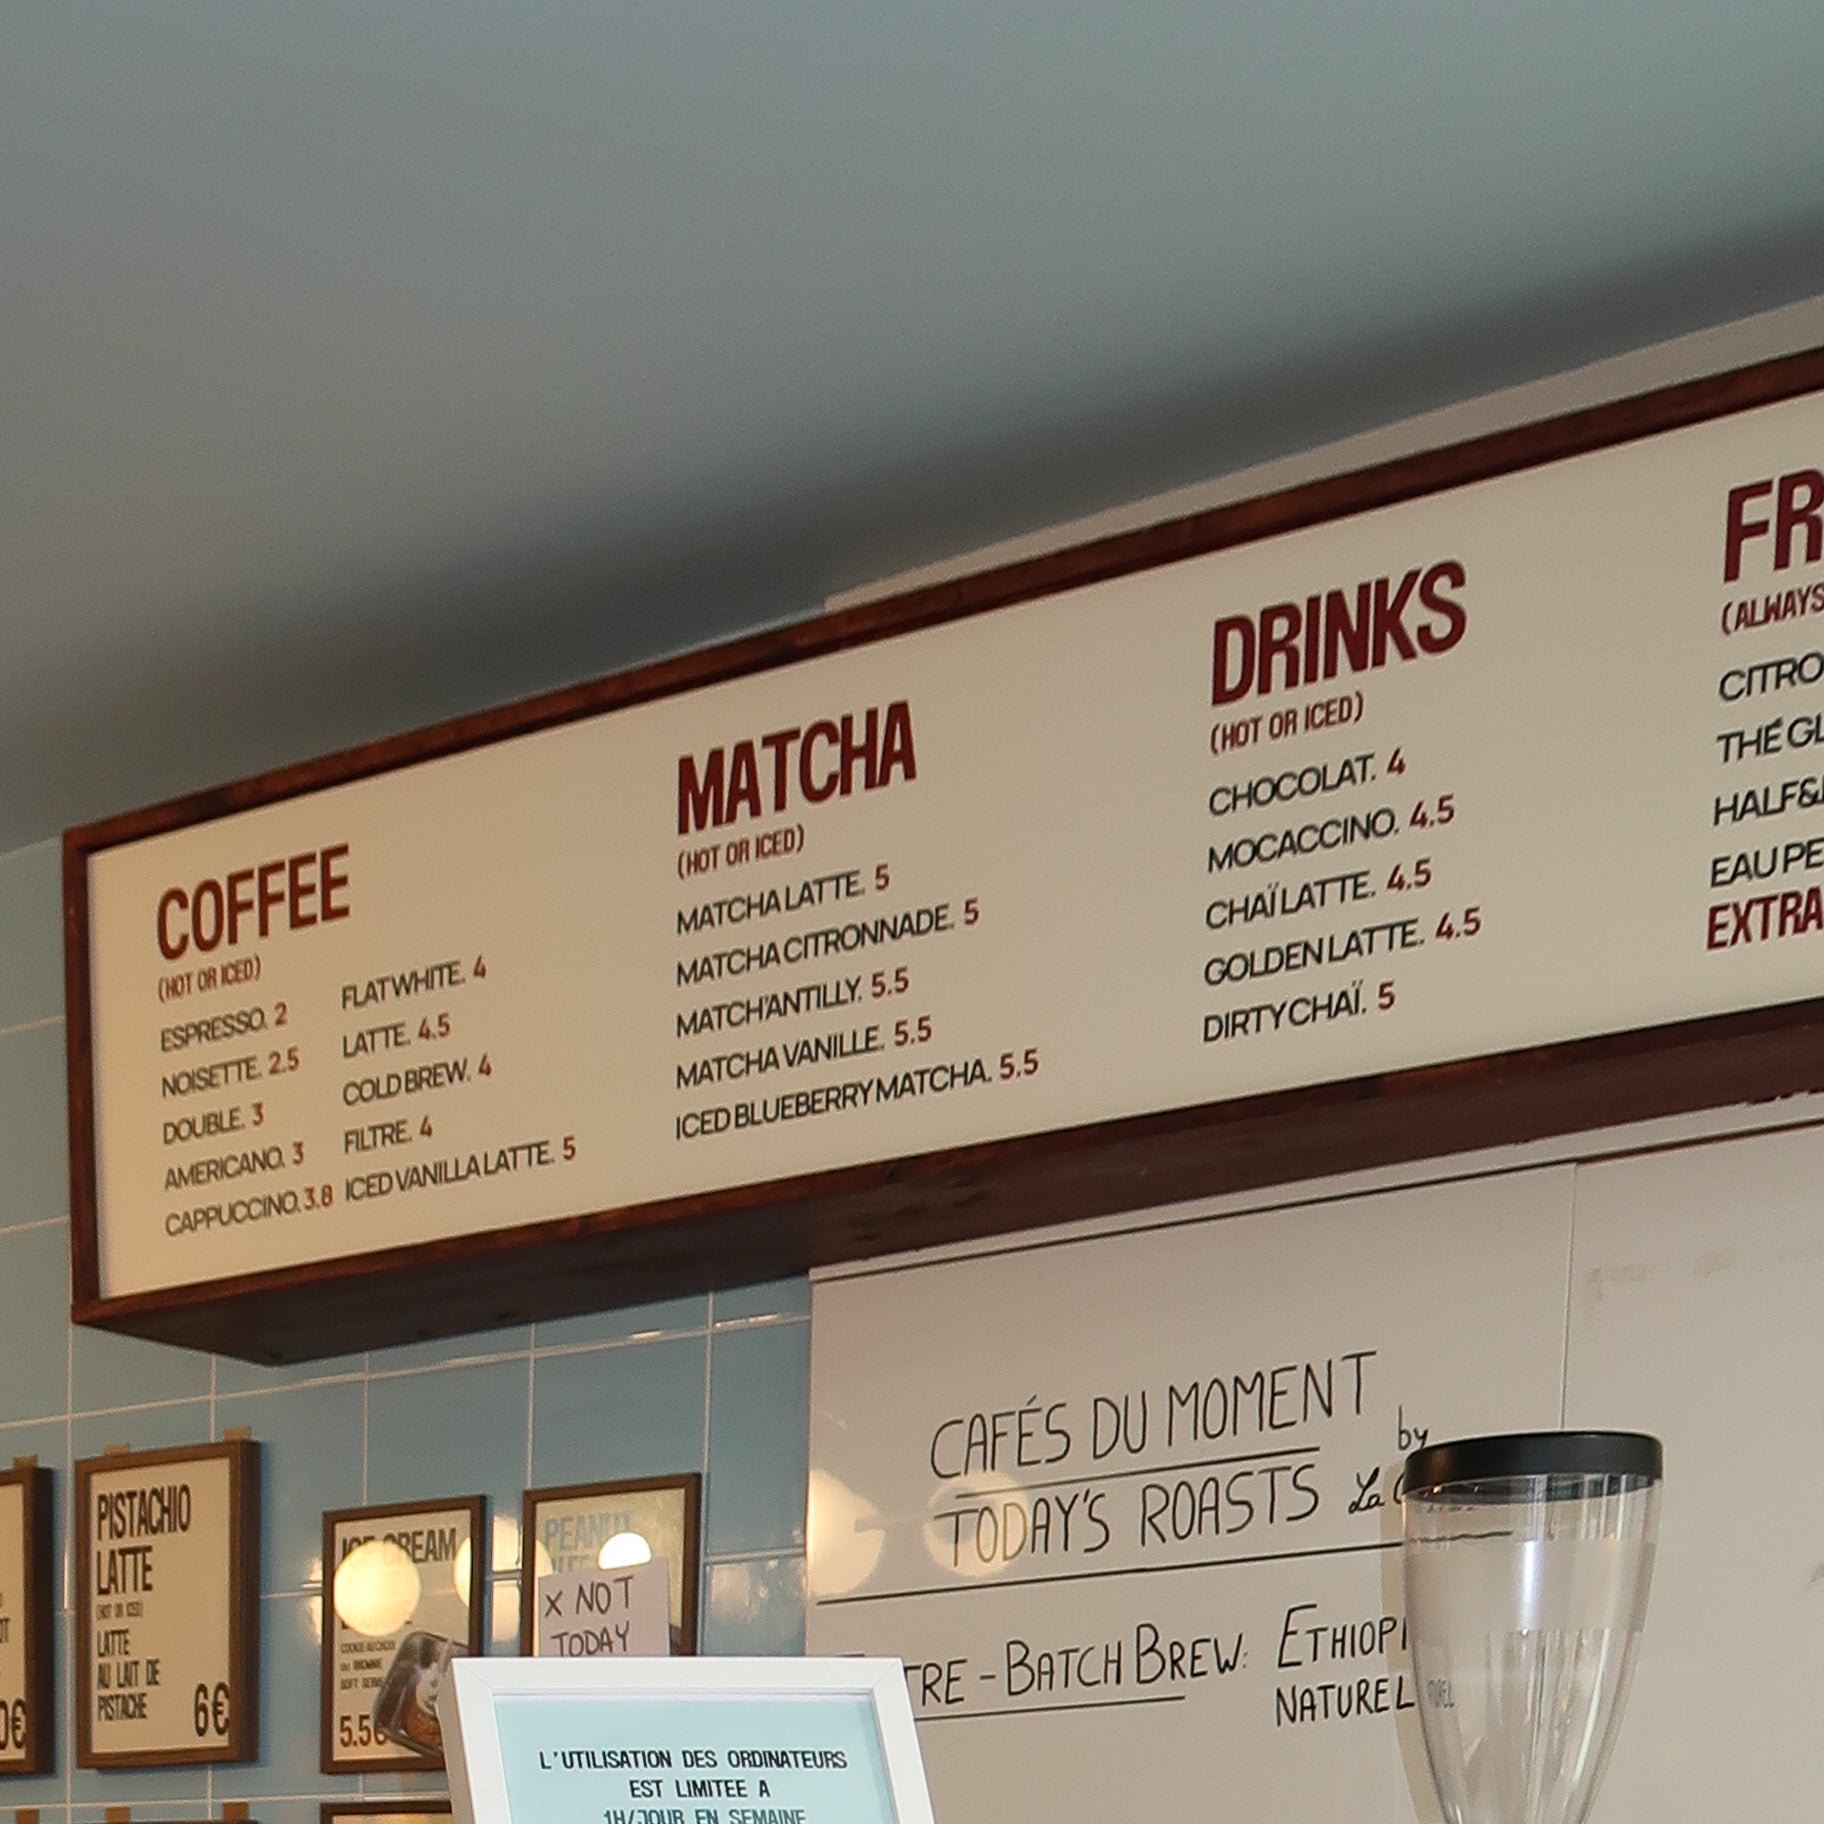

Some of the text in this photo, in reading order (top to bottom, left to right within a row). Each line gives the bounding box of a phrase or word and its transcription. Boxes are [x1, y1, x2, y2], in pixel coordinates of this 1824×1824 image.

[1211, 560, 1467, 706] DRINKS
[1210, 690, 1364, 755] (HOT OR ICED)
[1716, 717, 1783, 763] THÉ
[678, 700, 917, 836] MATCHA
[1209, 748, 1406, 816] CHOCOLAT. 4
[677, 823, 805, 881] (HOT OR ICED)
[1208, 793, 1456, 874] MOCACCINO. 4.5
[1206, 856, 1433, 930] CHAÏ LATTE. 4.5
[1711, 846, 1778, 888] EAU
[157, 843, 351, 960] COFFEE
[677, 863, 890, 935] MATCHA LATTE. 5
[1707, 886, 1824, 950] EXTRA
[473, 955, 487, 979] 4
[677, 896, 979, 987] MATCHA CITRONNADE. 5
[1205, 905, 1482, 987] GOLDEN LATTE. 4.5
[158, 953, 262, 1003] (HOT OR ICED)
[870, 965, 909, 999] 5.5
[161, 1001, 288, 1052] ESPRESSO. 2
[343, 1012, 451, 1059] LATTE. 4.5
[1203, 1000, 1287, 1043] DIRTY
[1377, 980, 1396, 1011] 5
[162, 1045, 300, 1098] NOISETTE. 2.5
[677, 1015, 932, 1090] MATCHA VANILLE. 5.5
[343, 1053, 493, 1107] COLD BREW. 4
[676, 1047, 1039, 1141] ICED BLUEBERRY MATCHA. 5.5
[163, 1102, 265, 1146] DOUBLE. 3
[345, 1115, 434, 1153] FILTRE. 4
[165, 1140, 305, 1191] AMERICANO. 3
[345, 1135, 577, 1202] ICED VANILLA LATTE. 5
[165, 1184, 334, 1238] CAPPUCCINO. 3.8
[930, 1350, 1378, 1480] CAFÉS DU MOMENT
[97, 1483, 192, 1541] PISTACHIO
[932, 1488, 1111, 1568] TODAY'S
[1140, 1463, 1320, 1547] ROASTS
[96, 1545, 153, 1596] LATTE
[575, 1575, 635, 1615] NOT
[97, 1628, 129, 1658] LATTE
[551, 1620, 630, 1657] TODAY
[96, 1658, 160, 1689] AU LAIT DE
[97, 1692, 148, 1721] PISTACHE
[193, 1681, 230, 1737] 6€
[1275, 1675, 1416, 1727] NATUREL
[539, 1749, 848, 1770] L'UTILISATION DES ORDINATEURS
[629, 1779, 771, 1799] EST LIMITEE A
